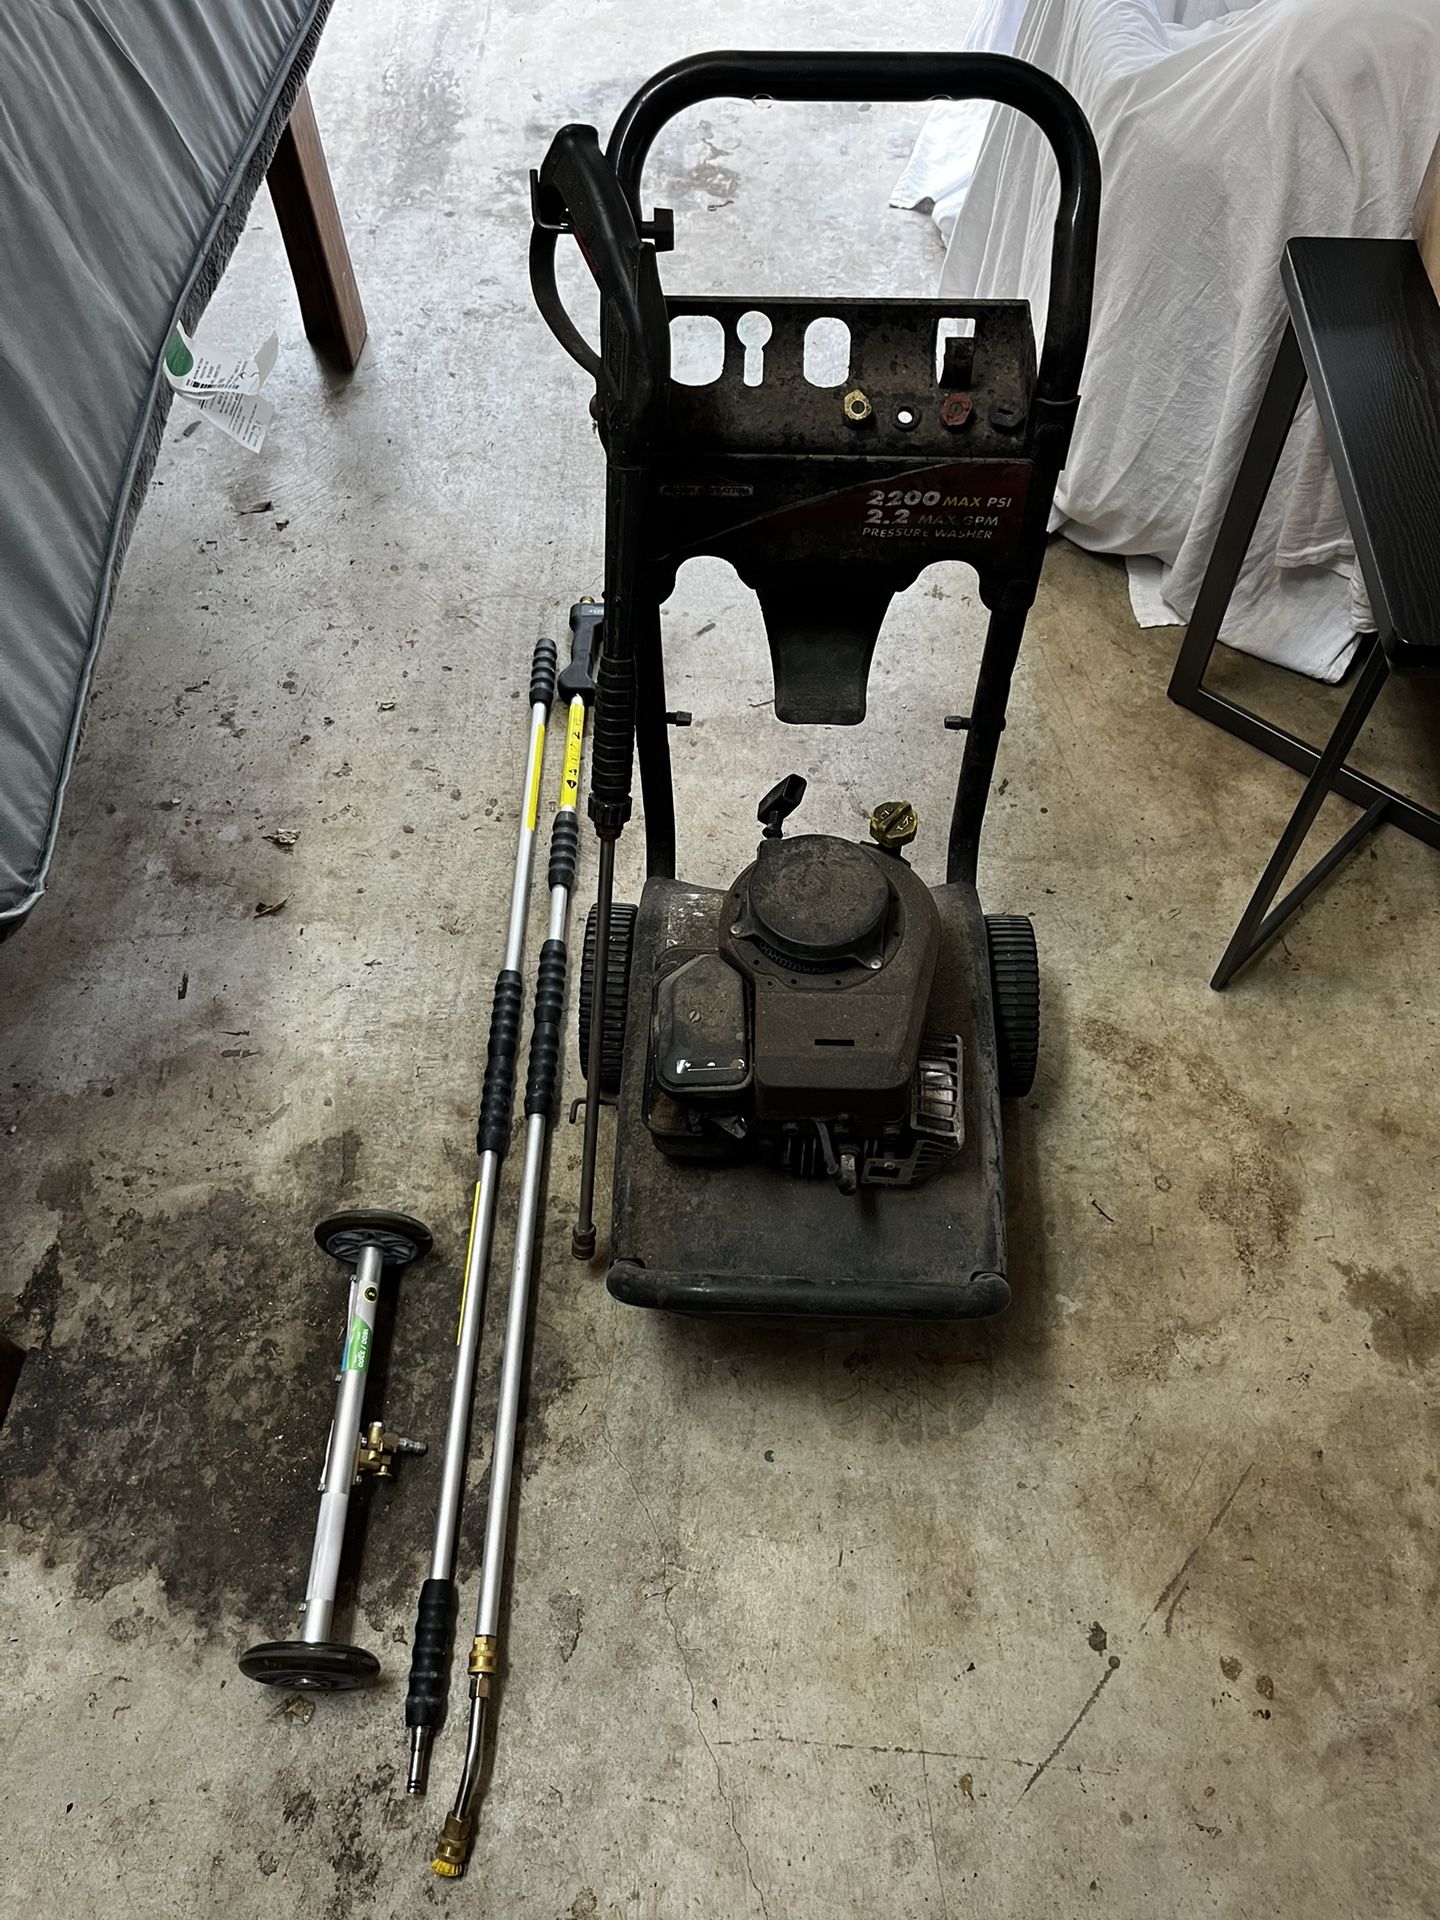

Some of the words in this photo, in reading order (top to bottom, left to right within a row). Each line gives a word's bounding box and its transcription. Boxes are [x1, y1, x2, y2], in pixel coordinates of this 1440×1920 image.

[865, 489, 941, 507] 2200
[942, 496, 982, 507] MAX
[986, 496, 1013, 508] PSI
[864, 508, 911, 525] 2.2
[917, 514, 956, 525] MAX
[962, 515, 1000, 526] GPM
[862, 527, 929, 538] PRESSURE
[934, 529, 993, 539] WASHER
